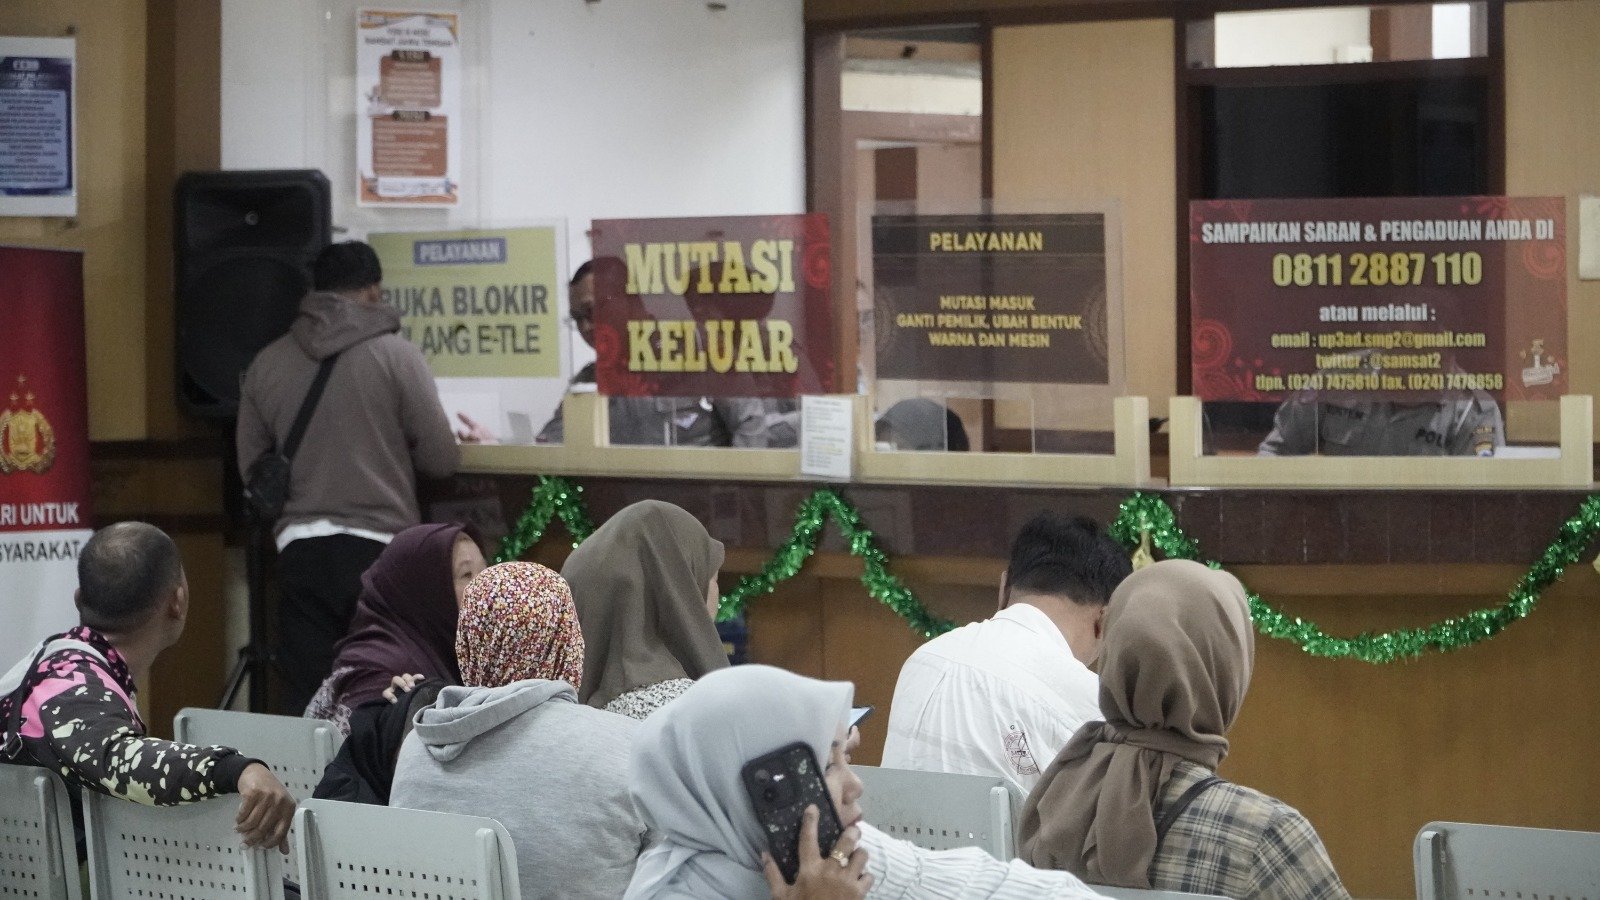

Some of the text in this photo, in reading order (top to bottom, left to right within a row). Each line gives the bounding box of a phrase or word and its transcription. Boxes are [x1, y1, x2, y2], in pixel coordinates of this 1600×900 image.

[929, 231, 1043, 252] PELAYANAN
[1202, 218, 1554, 244] SAMPAIKAN SARAN & PENGADUAN ANDA DI
[419, 240, 502, 263] PELAYANAN
[624, 239, 796, 296] MUTASI
[1272, 251, 1483, 287] 0811 2887 110
[453, 284, 548, 316] BLOKIR
[939, 295, 1036, 311] MUTASI MASUK
[896, 313, 1082, 330] GANTI PEMILIK, UBAH BENTUK
[1319, 304, 1359, 322] atau
[1362, 303, 1428, 322] melalui
[477, 323, 541, 355] E-TLE
[626, 319, 799, 374] KELUAR
[927, 331, 1050, 348] WARNA DAN MESIN
[1271, 331, 1310, 347] email
[1318, 330, 1486, 349] up3ad.smg2@gmail.com
[1315, 353, 1362, 370] twitter
[1369, 353, 1442, 371] @samsat2
[1288, 374, 1324, 391] (024)
[1326, 373, 1380, 391] 7475810
[1408, 373, 1445, 391] (024)
[20, 501, 80, 525] UNTUK
[0, 541, 80, 562] YARAKAT
